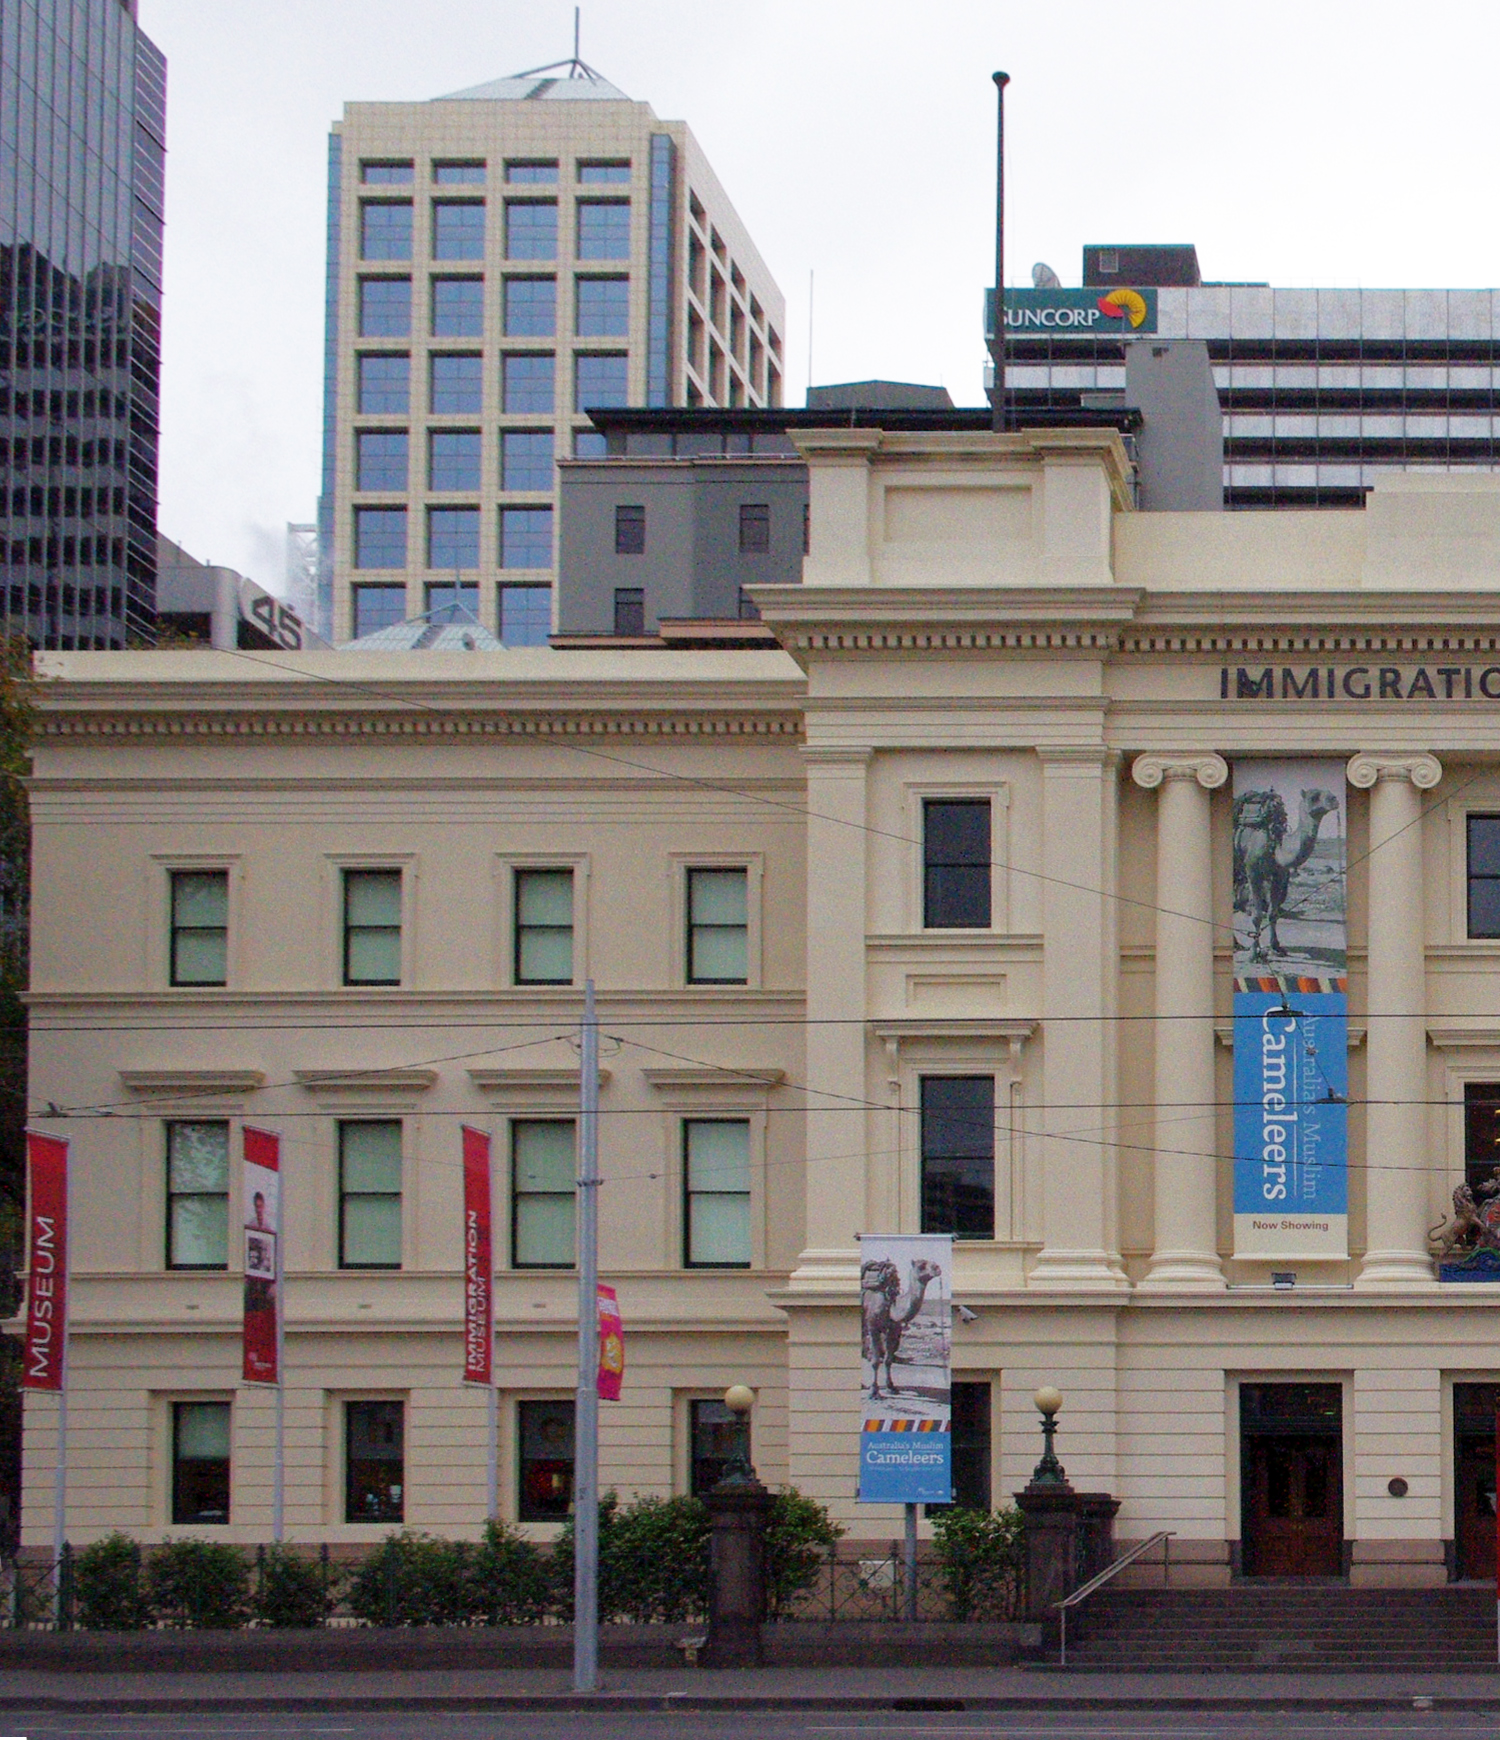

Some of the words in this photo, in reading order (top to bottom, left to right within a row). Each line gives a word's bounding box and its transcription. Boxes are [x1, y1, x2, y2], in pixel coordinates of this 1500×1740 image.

[252, 595, 302, 651] 45
[1262, 1006, 1298, 1200] Cameleers
[1303, 1011, 1322, 1115] Ausralias
[1303, 1122, 1323, 1200] Muslim
[1252, 1220, 1278, 1230] Now
[1281, 1220, 1329, 1232] Showing
[29, 1216, 54, 1377] MUSEUM
[467, 1210, 478, 1371] IMMIGRATION
[476, 1277, 487, 1373] MUSEUM
[866, 1450, 944, 1464] Cameleers
